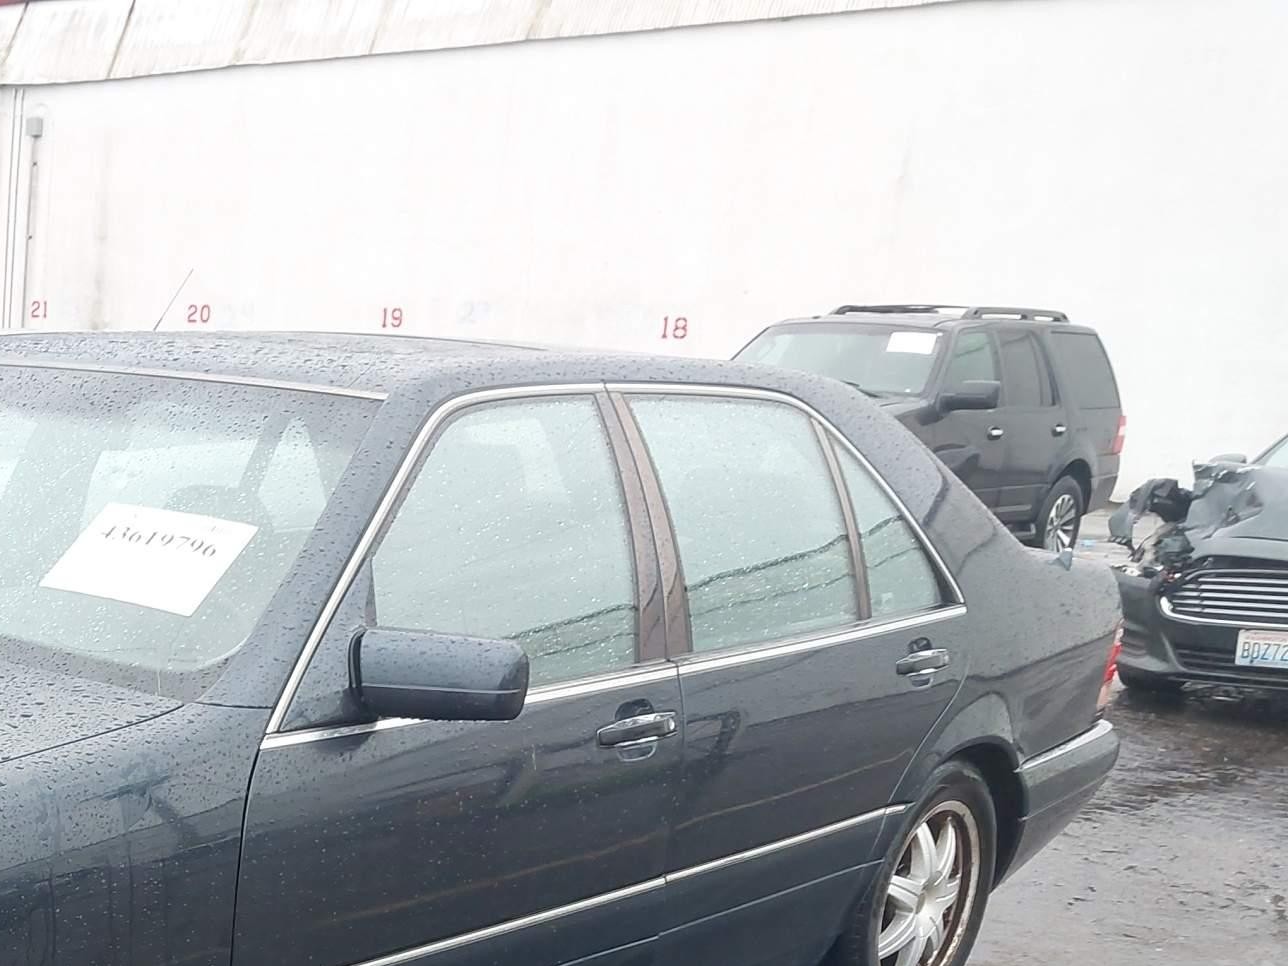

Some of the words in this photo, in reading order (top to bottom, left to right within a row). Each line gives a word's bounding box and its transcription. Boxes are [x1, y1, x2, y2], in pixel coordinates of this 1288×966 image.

[31, 300, 48, 319] 21
[187, 304, 211, 323] 20
[382, 307, 403, 328] 19
[661, 316, 688, 339] 18
